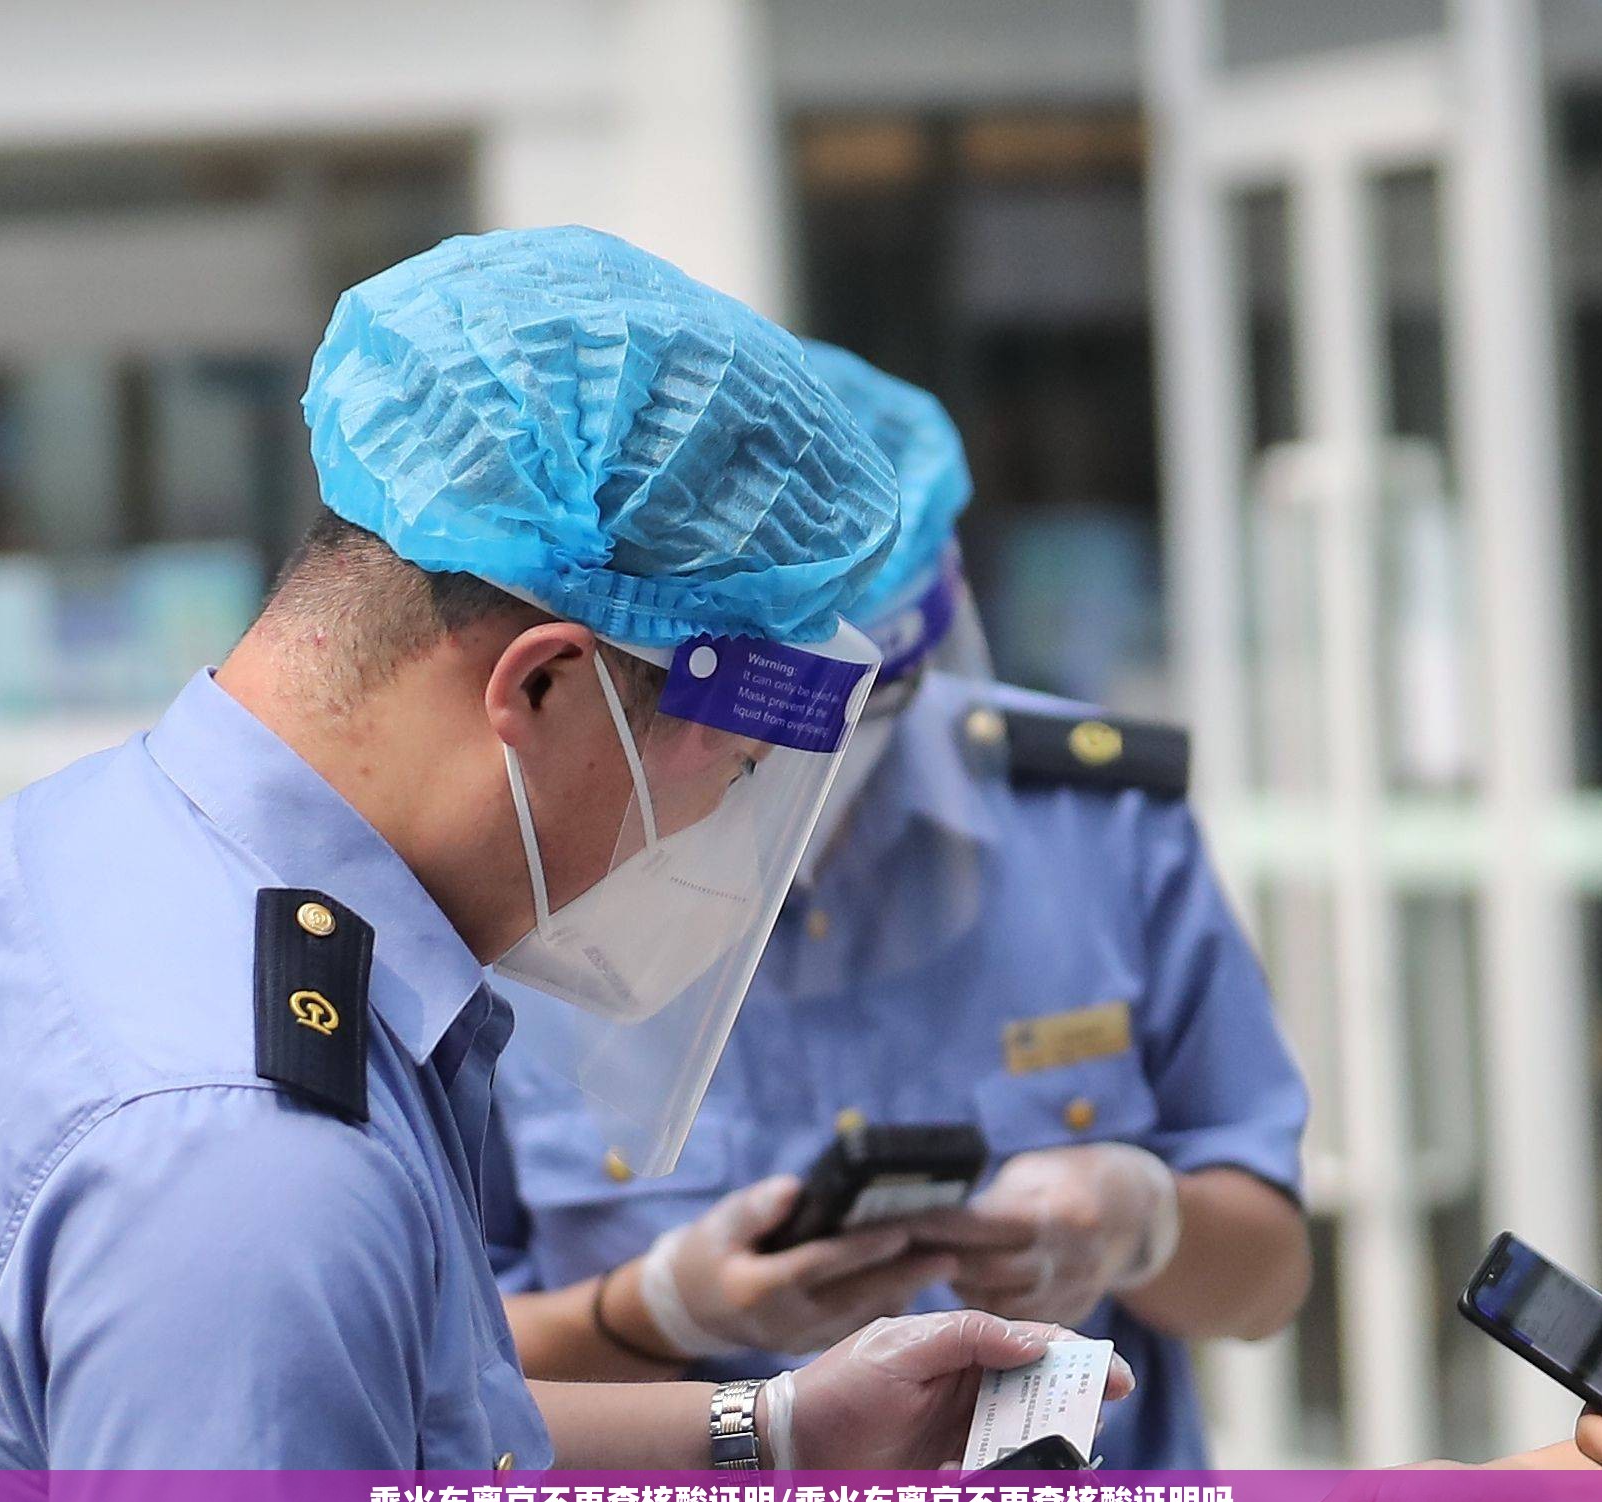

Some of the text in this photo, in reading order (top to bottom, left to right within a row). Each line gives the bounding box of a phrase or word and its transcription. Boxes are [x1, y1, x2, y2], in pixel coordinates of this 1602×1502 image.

[748, 652, 798, 677] Warning:
[752, 675, 772, 687] can
[774, 681, 797, 696] only
[738, 686, 766, 703] Mask
[768, 697, 805, 713] prevent
[733, 704, 761, 720] liquid
[763, 711, 786, 727] from
